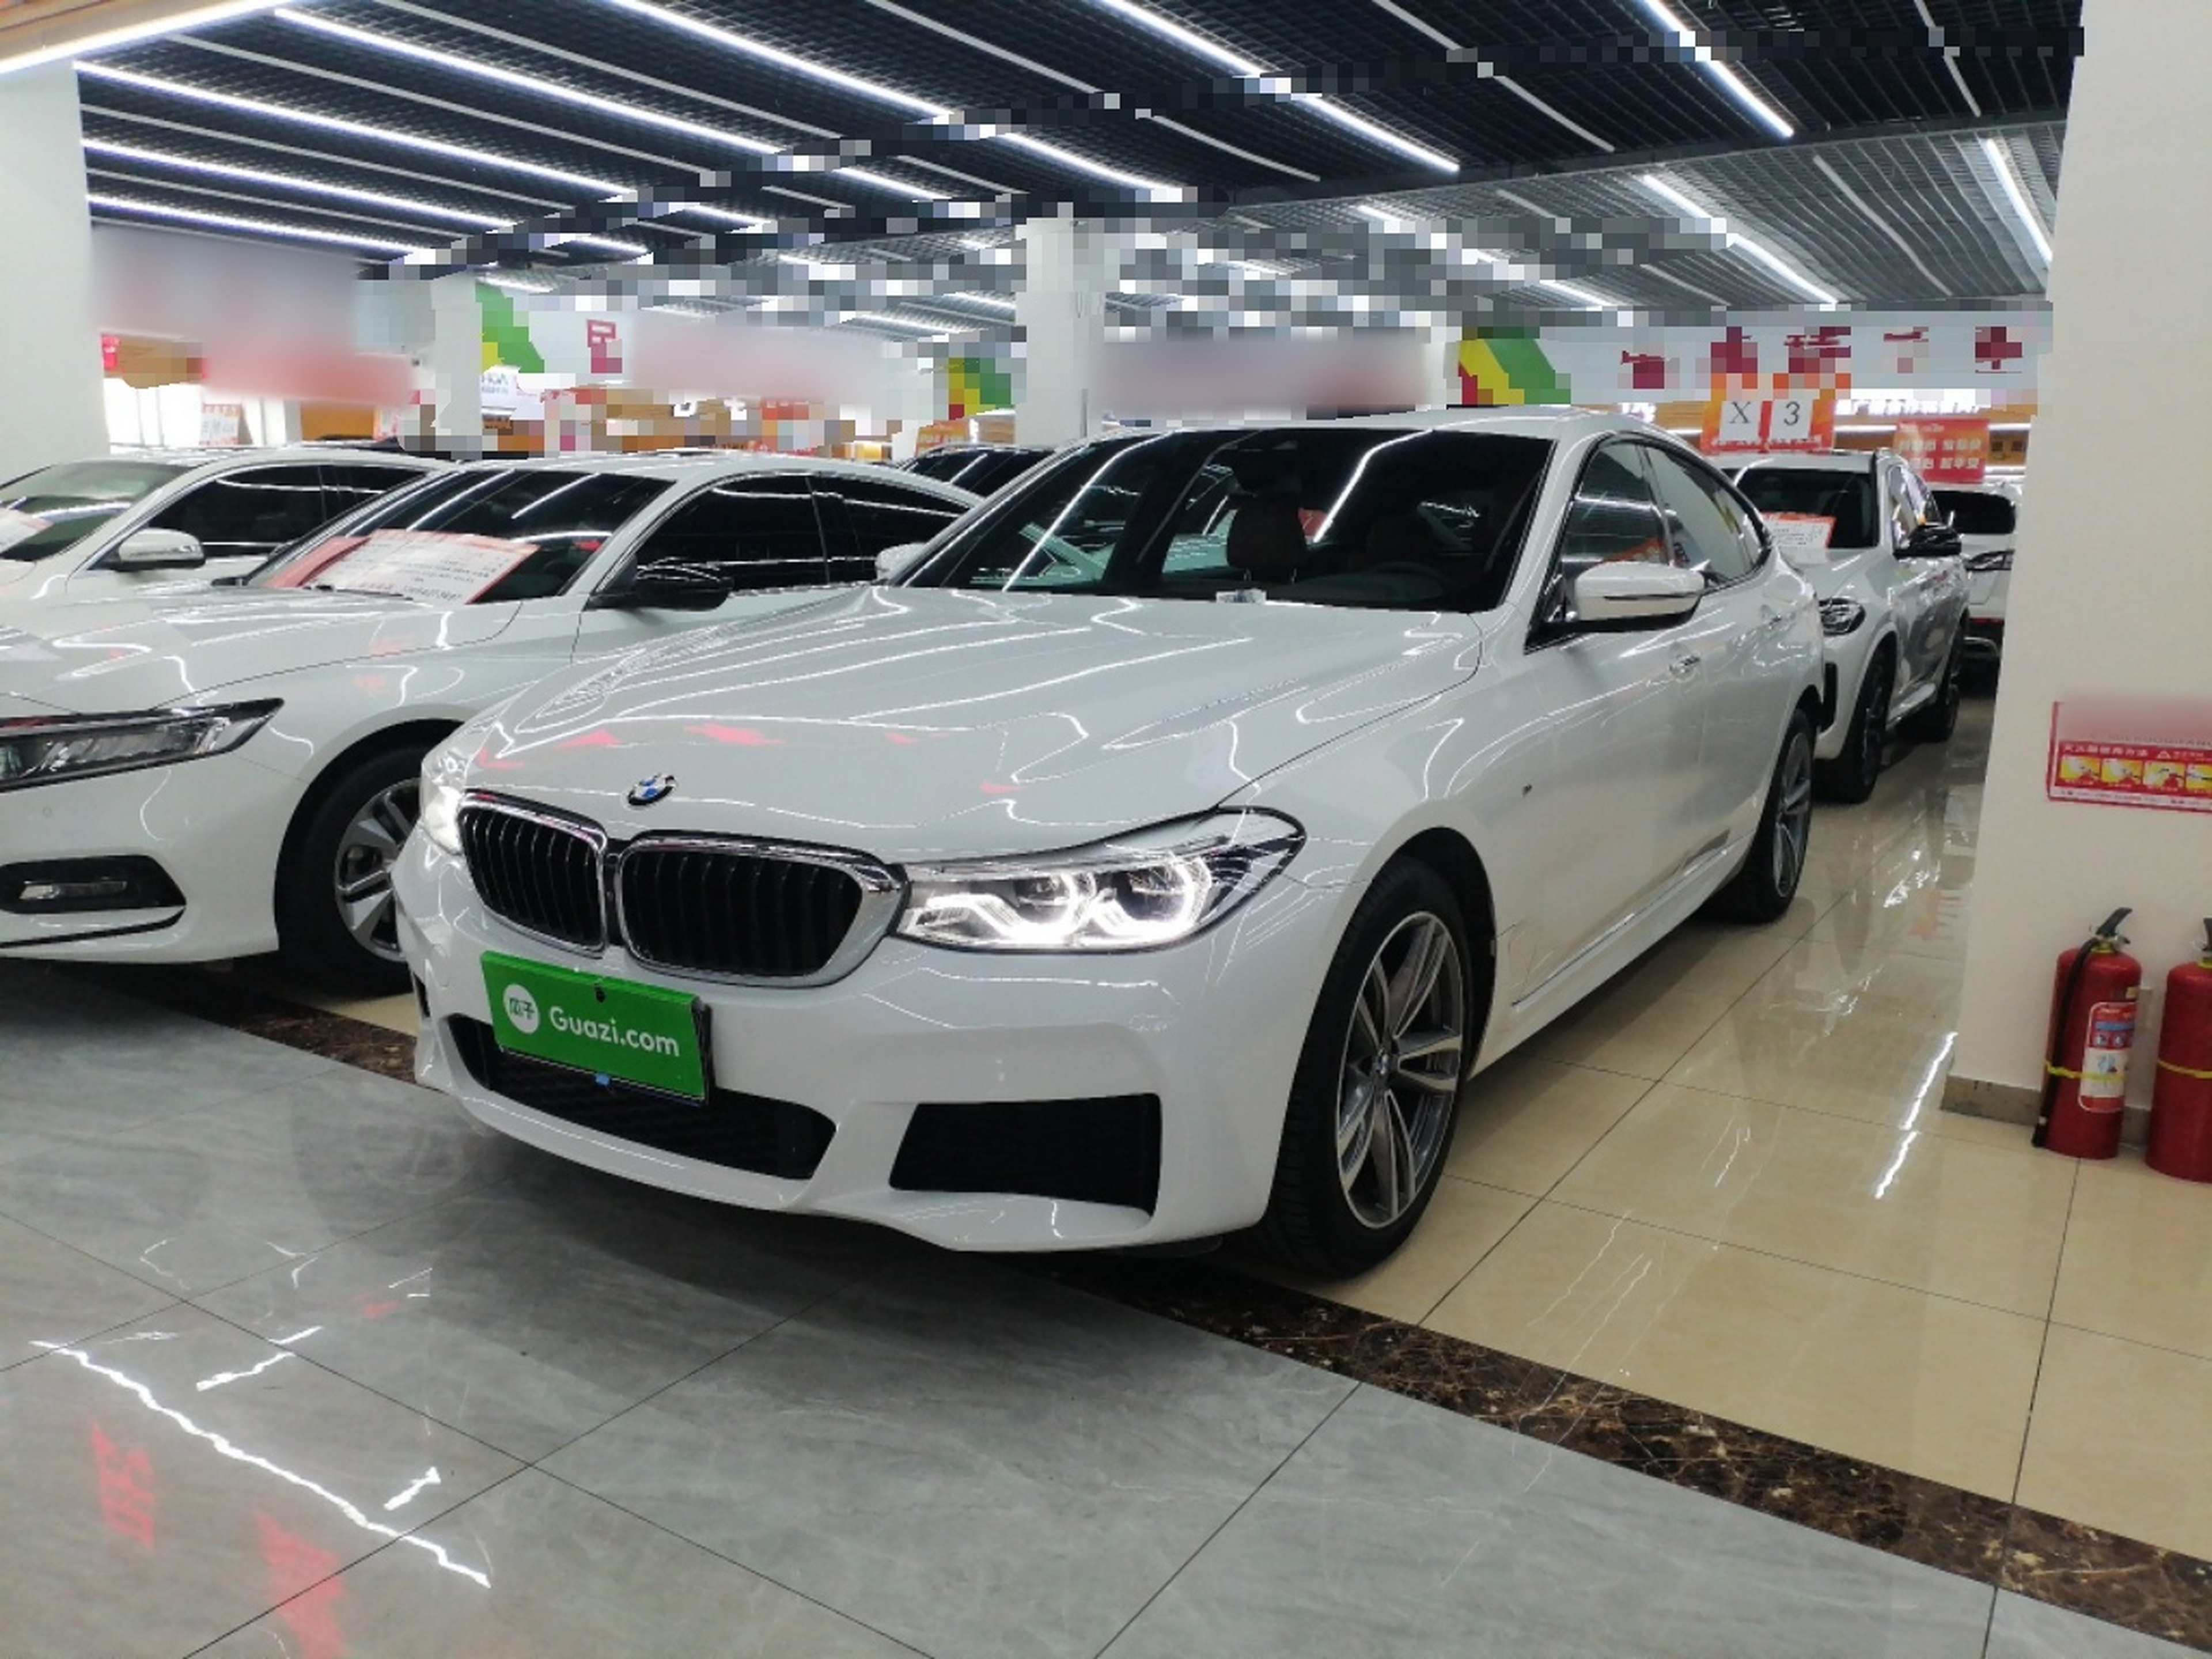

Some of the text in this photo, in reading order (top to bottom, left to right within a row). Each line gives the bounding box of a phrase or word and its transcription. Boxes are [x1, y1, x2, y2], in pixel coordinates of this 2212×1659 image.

[1729, 401, 1801, 426] X 3
[550, 1006, 680, 1057] Guazi.com
